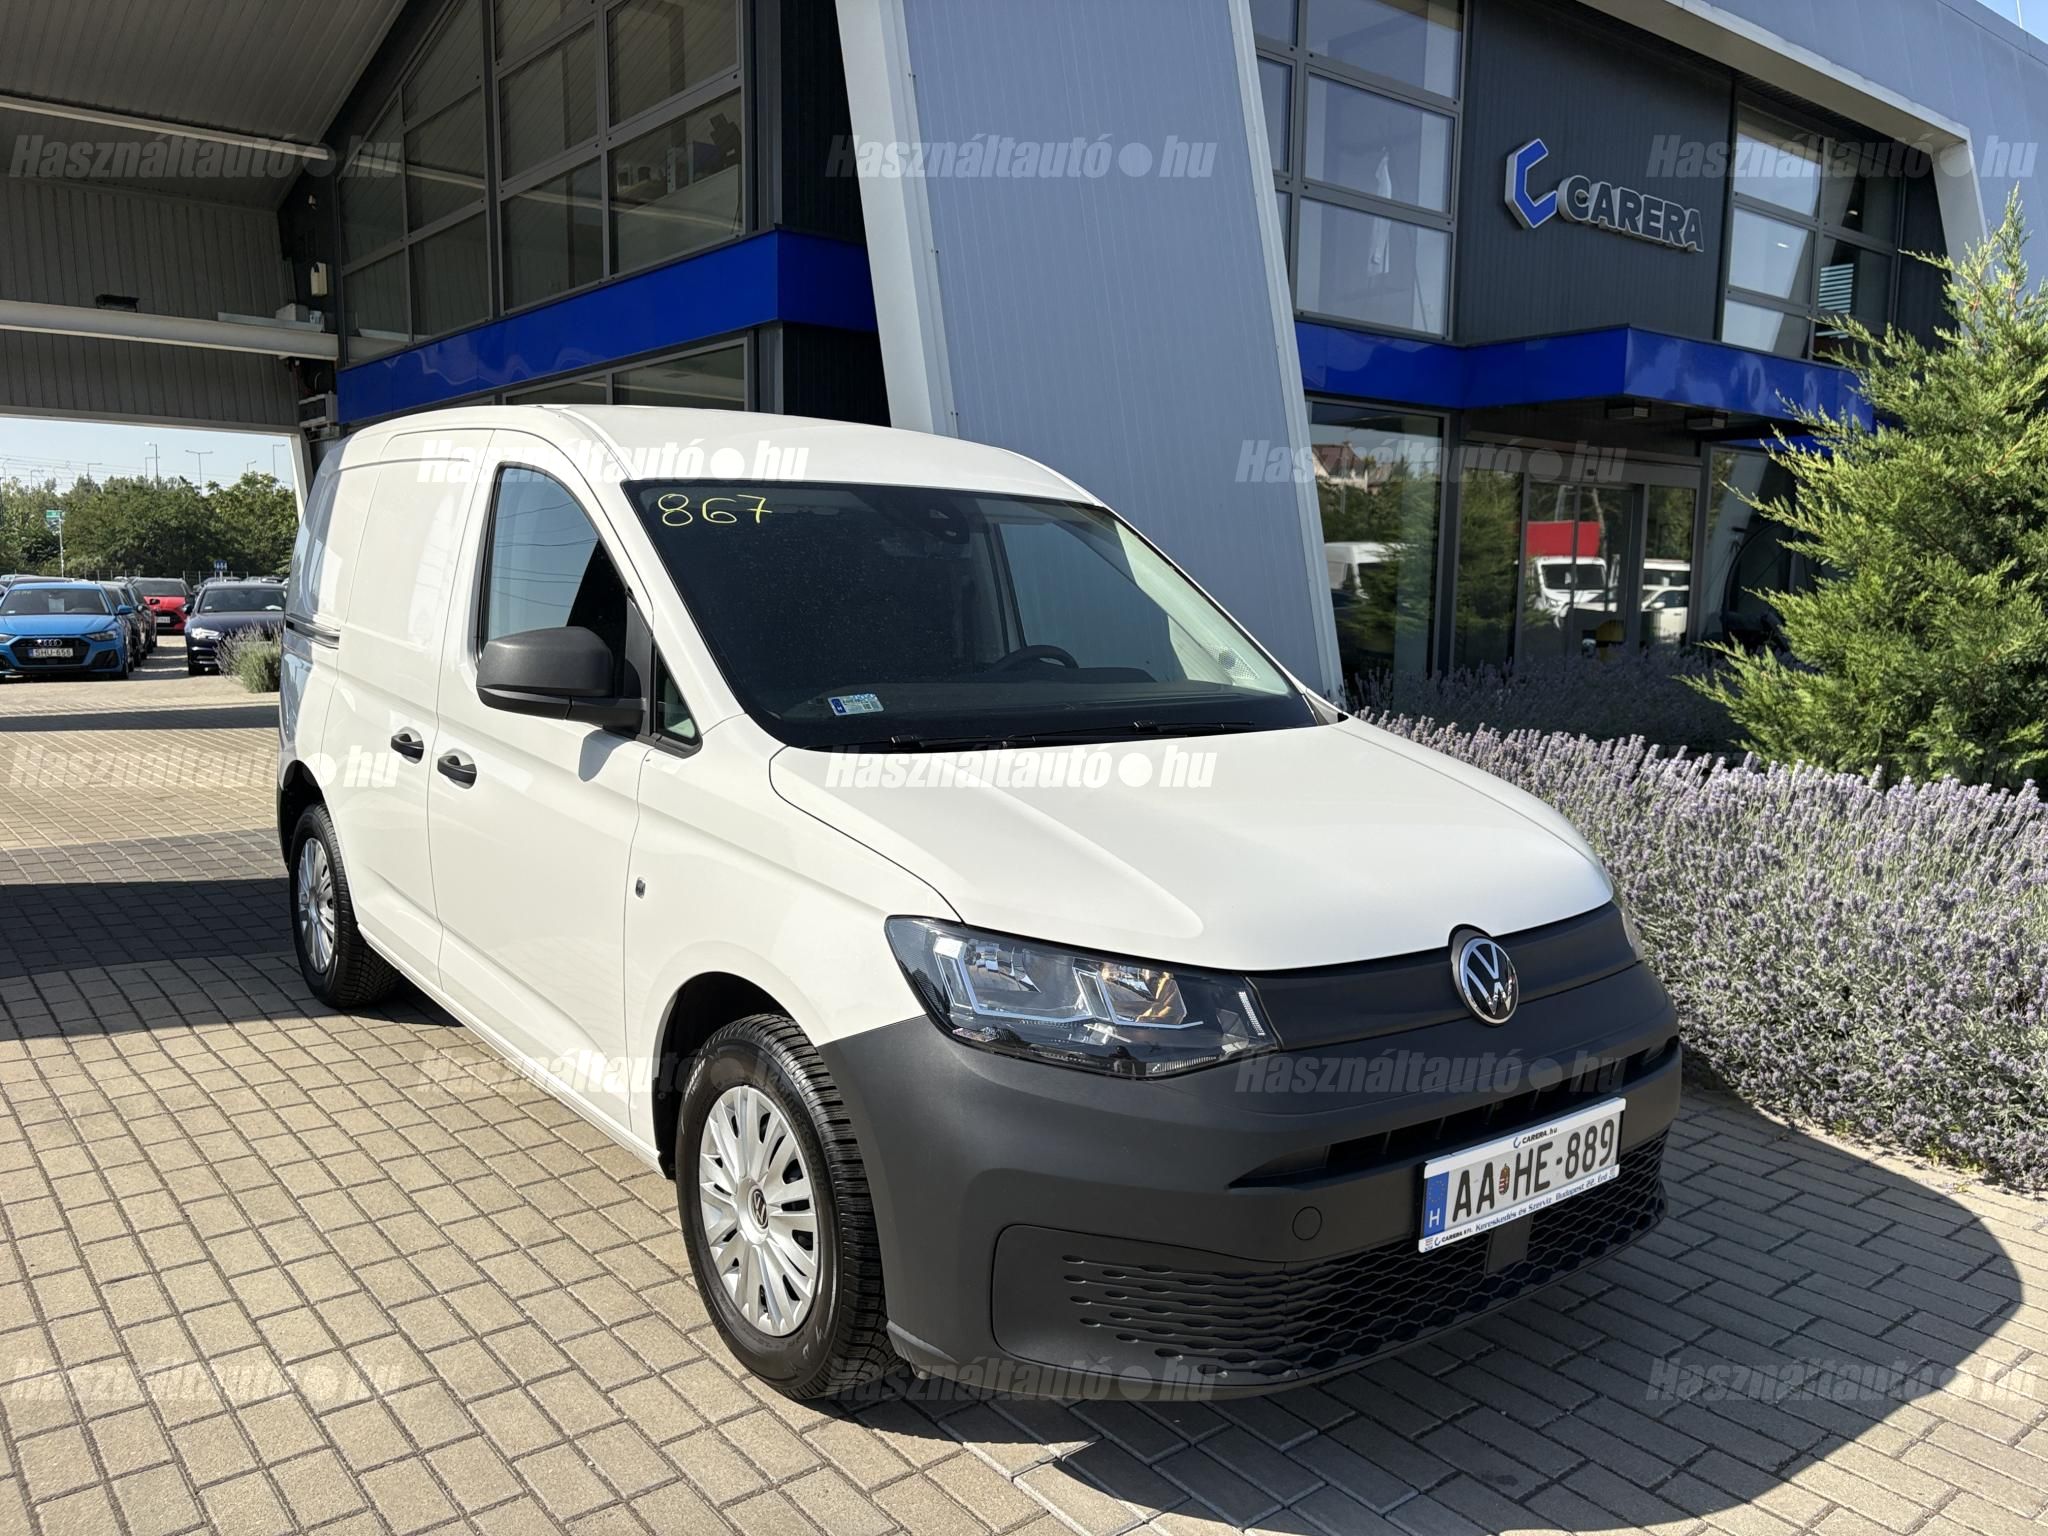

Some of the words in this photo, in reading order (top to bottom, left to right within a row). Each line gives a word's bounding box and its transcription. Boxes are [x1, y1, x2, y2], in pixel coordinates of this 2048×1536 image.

[1557, 175, 1704, 252] CARERA
[657, 493, 773, 527] 867
[1428, 1207, 1440, 1228] H
